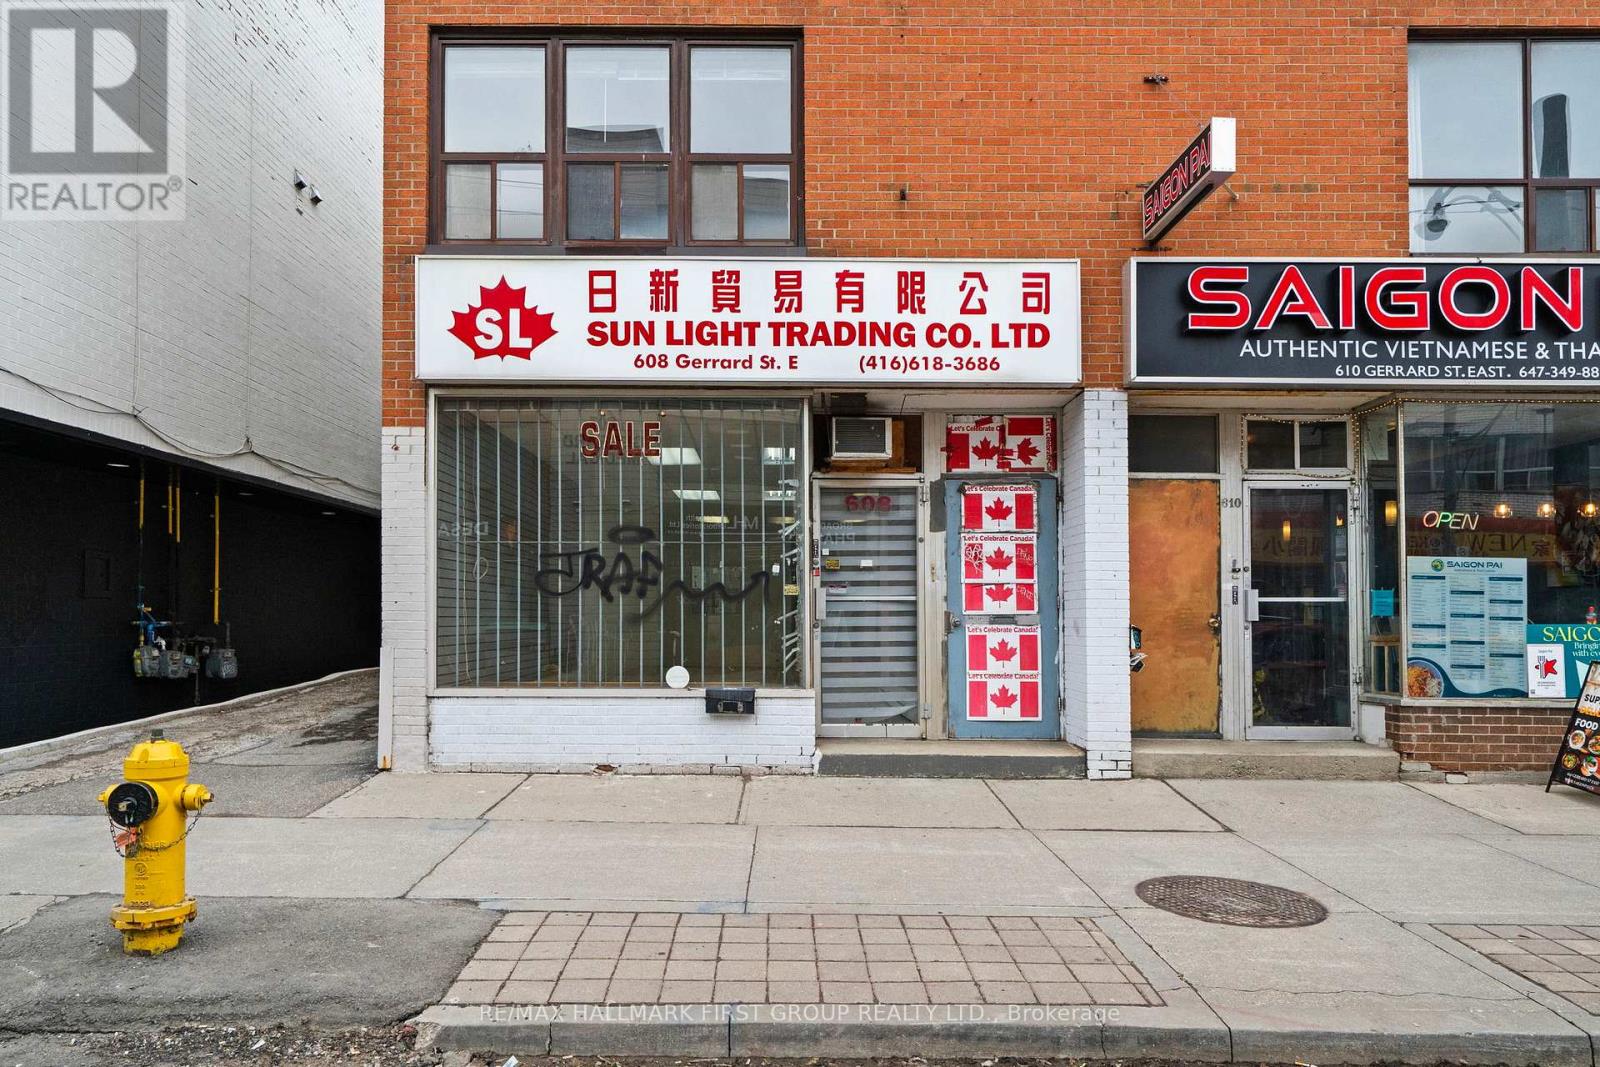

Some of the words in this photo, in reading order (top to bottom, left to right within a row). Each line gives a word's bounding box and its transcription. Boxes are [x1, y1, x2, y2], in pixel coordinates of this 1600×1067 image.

[1144, 157, 1189, 229] SAIGON
[1190, 131, 1211, 183] PAI
[588, 268, 1051, 314] 日新貿易有限公司
[1187, 265, 1583, 332] SAIGON
[473, 307, 533, 350] SL
[586, 320, 656, 347] SUN
[665, 321, 761, 347] LIGHT
[772, 321, 916, 348] TRADING
[925, 322, 981, 348] CO.
[991, 323, 1051, 349] LTD
[1239, 340, 1378, 358] AUTHENTIC
[1385, 341, 1528, 359] VIETNAMESE
[1535, 342, 1550, 360] &
[633, 354, 669, 369] 608
[675, 354, 753, 370] Gerrard
[760, 355, 781, 370] St.
[788, 355, 798, 370] E
[859, 355, 1001, 374] (416)618-3686
[1335, 365, 1361, 377] 610
[1365, 365, 1440, 377] GERRARD
[1519, 366, 1600, 378] 647-349-88
[579, 420, 662, 459] SALE
[1423, 510, 1480, 530] OPEN
[1446, 560, 1485, 568] SAIGON
[1486, 561, 1503, 569] PAI
[1572, 649, 1589, 657] with
[967, 672, 983, 680] Let's
[983, 672, 1014, 680] Celebrate
[1584, 693, 1600, 704] SUP
[1574, 717, 1599, 731] FOOD
